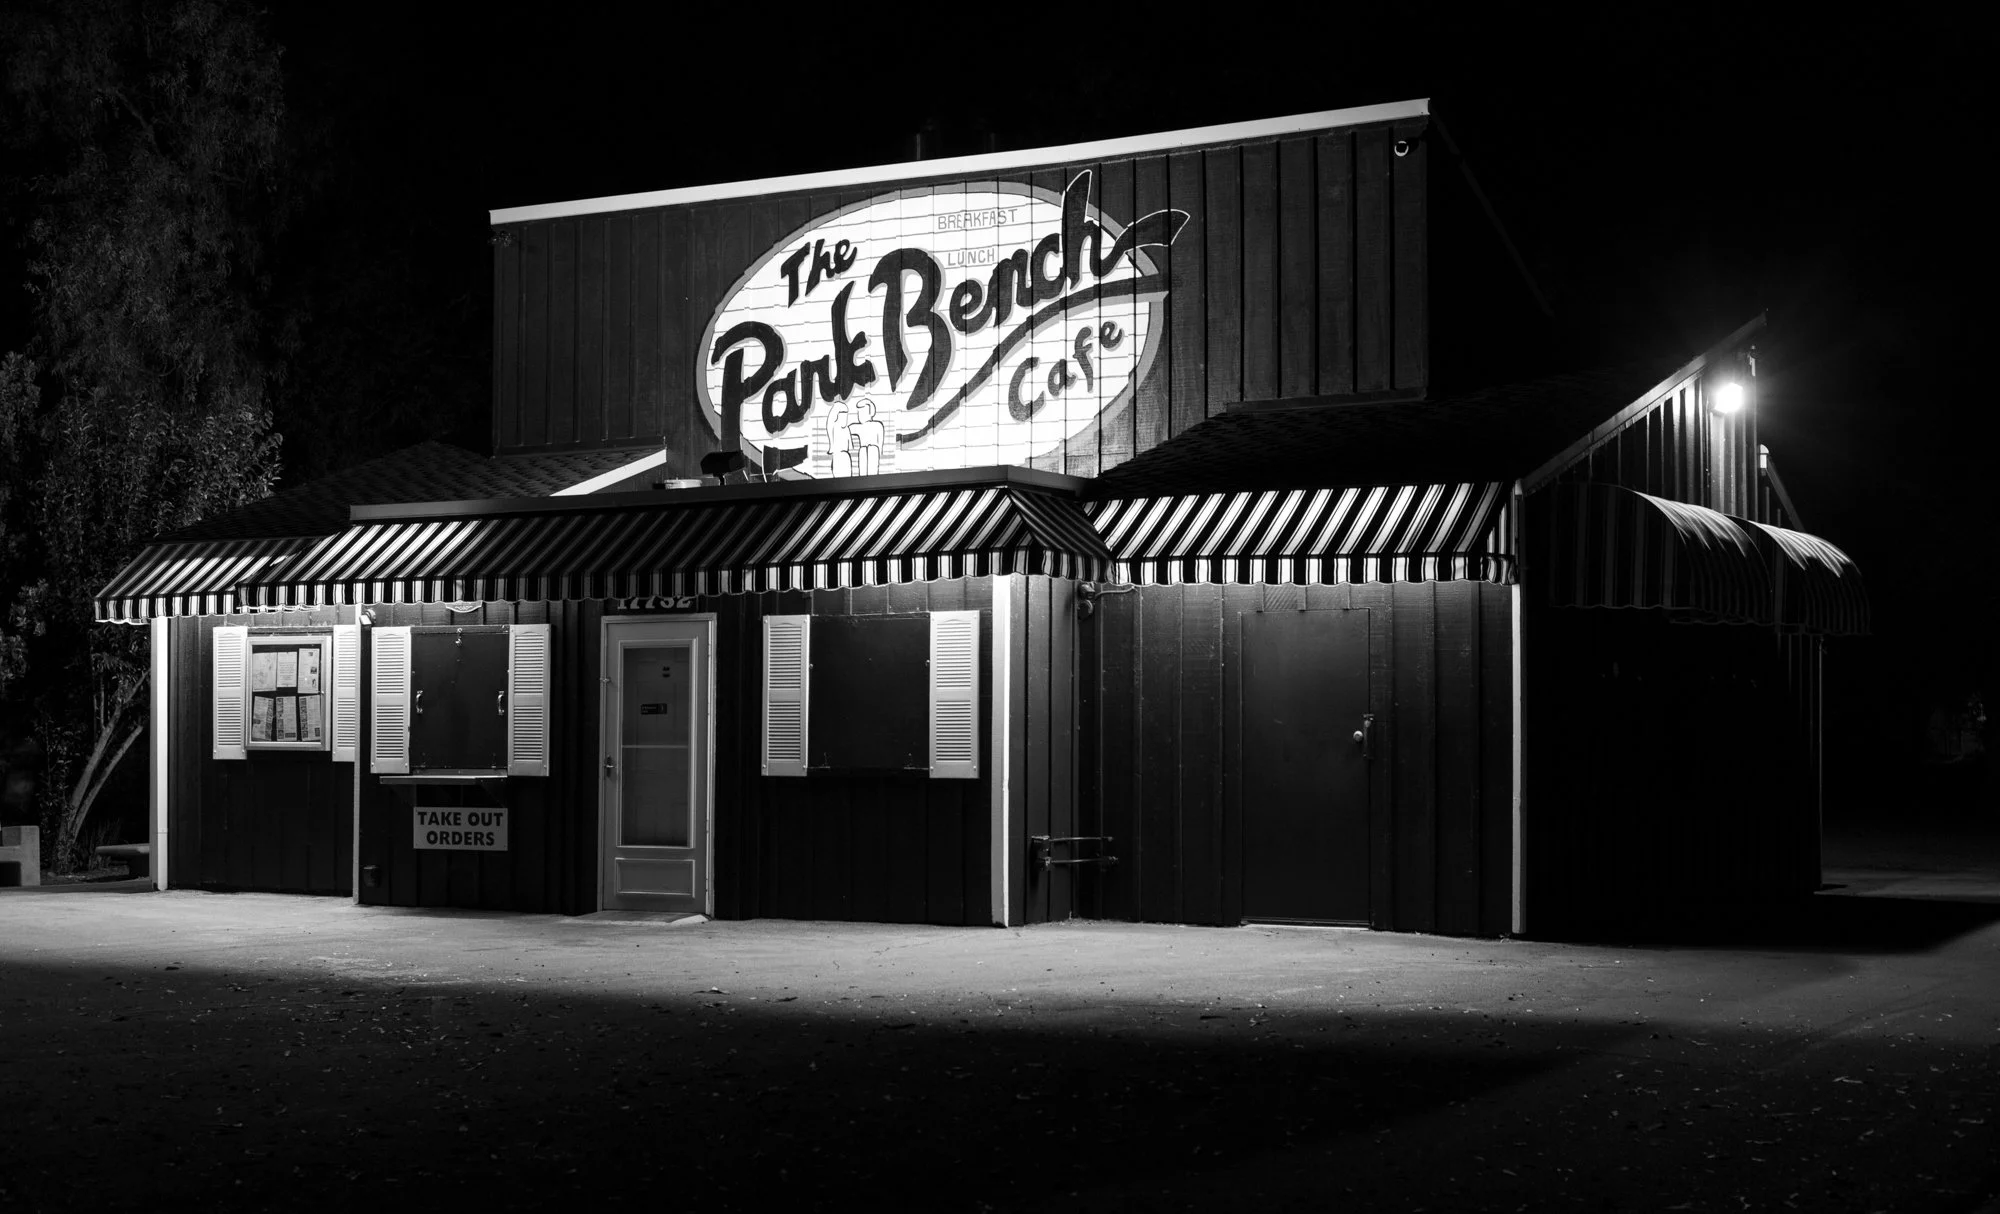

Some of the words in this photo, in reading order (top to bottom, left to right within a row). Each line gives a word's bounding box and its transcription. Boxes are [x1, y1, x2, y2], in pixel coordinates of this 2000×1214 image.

[937, 208, 1018, 230] BREAKFAST
[947, 248, 996, 266] LUNCH
[780, 238, 858, 309] The
[710, 280, 878, 472] Park
[867, 168, 1190, 411] Bench
[1008, 320, 1124, 422] Cafe
[417, 811, 462, 826] TAKE
[467, 812, 504, 827] OUT
[426, 831, 495, 846] ORDERS
